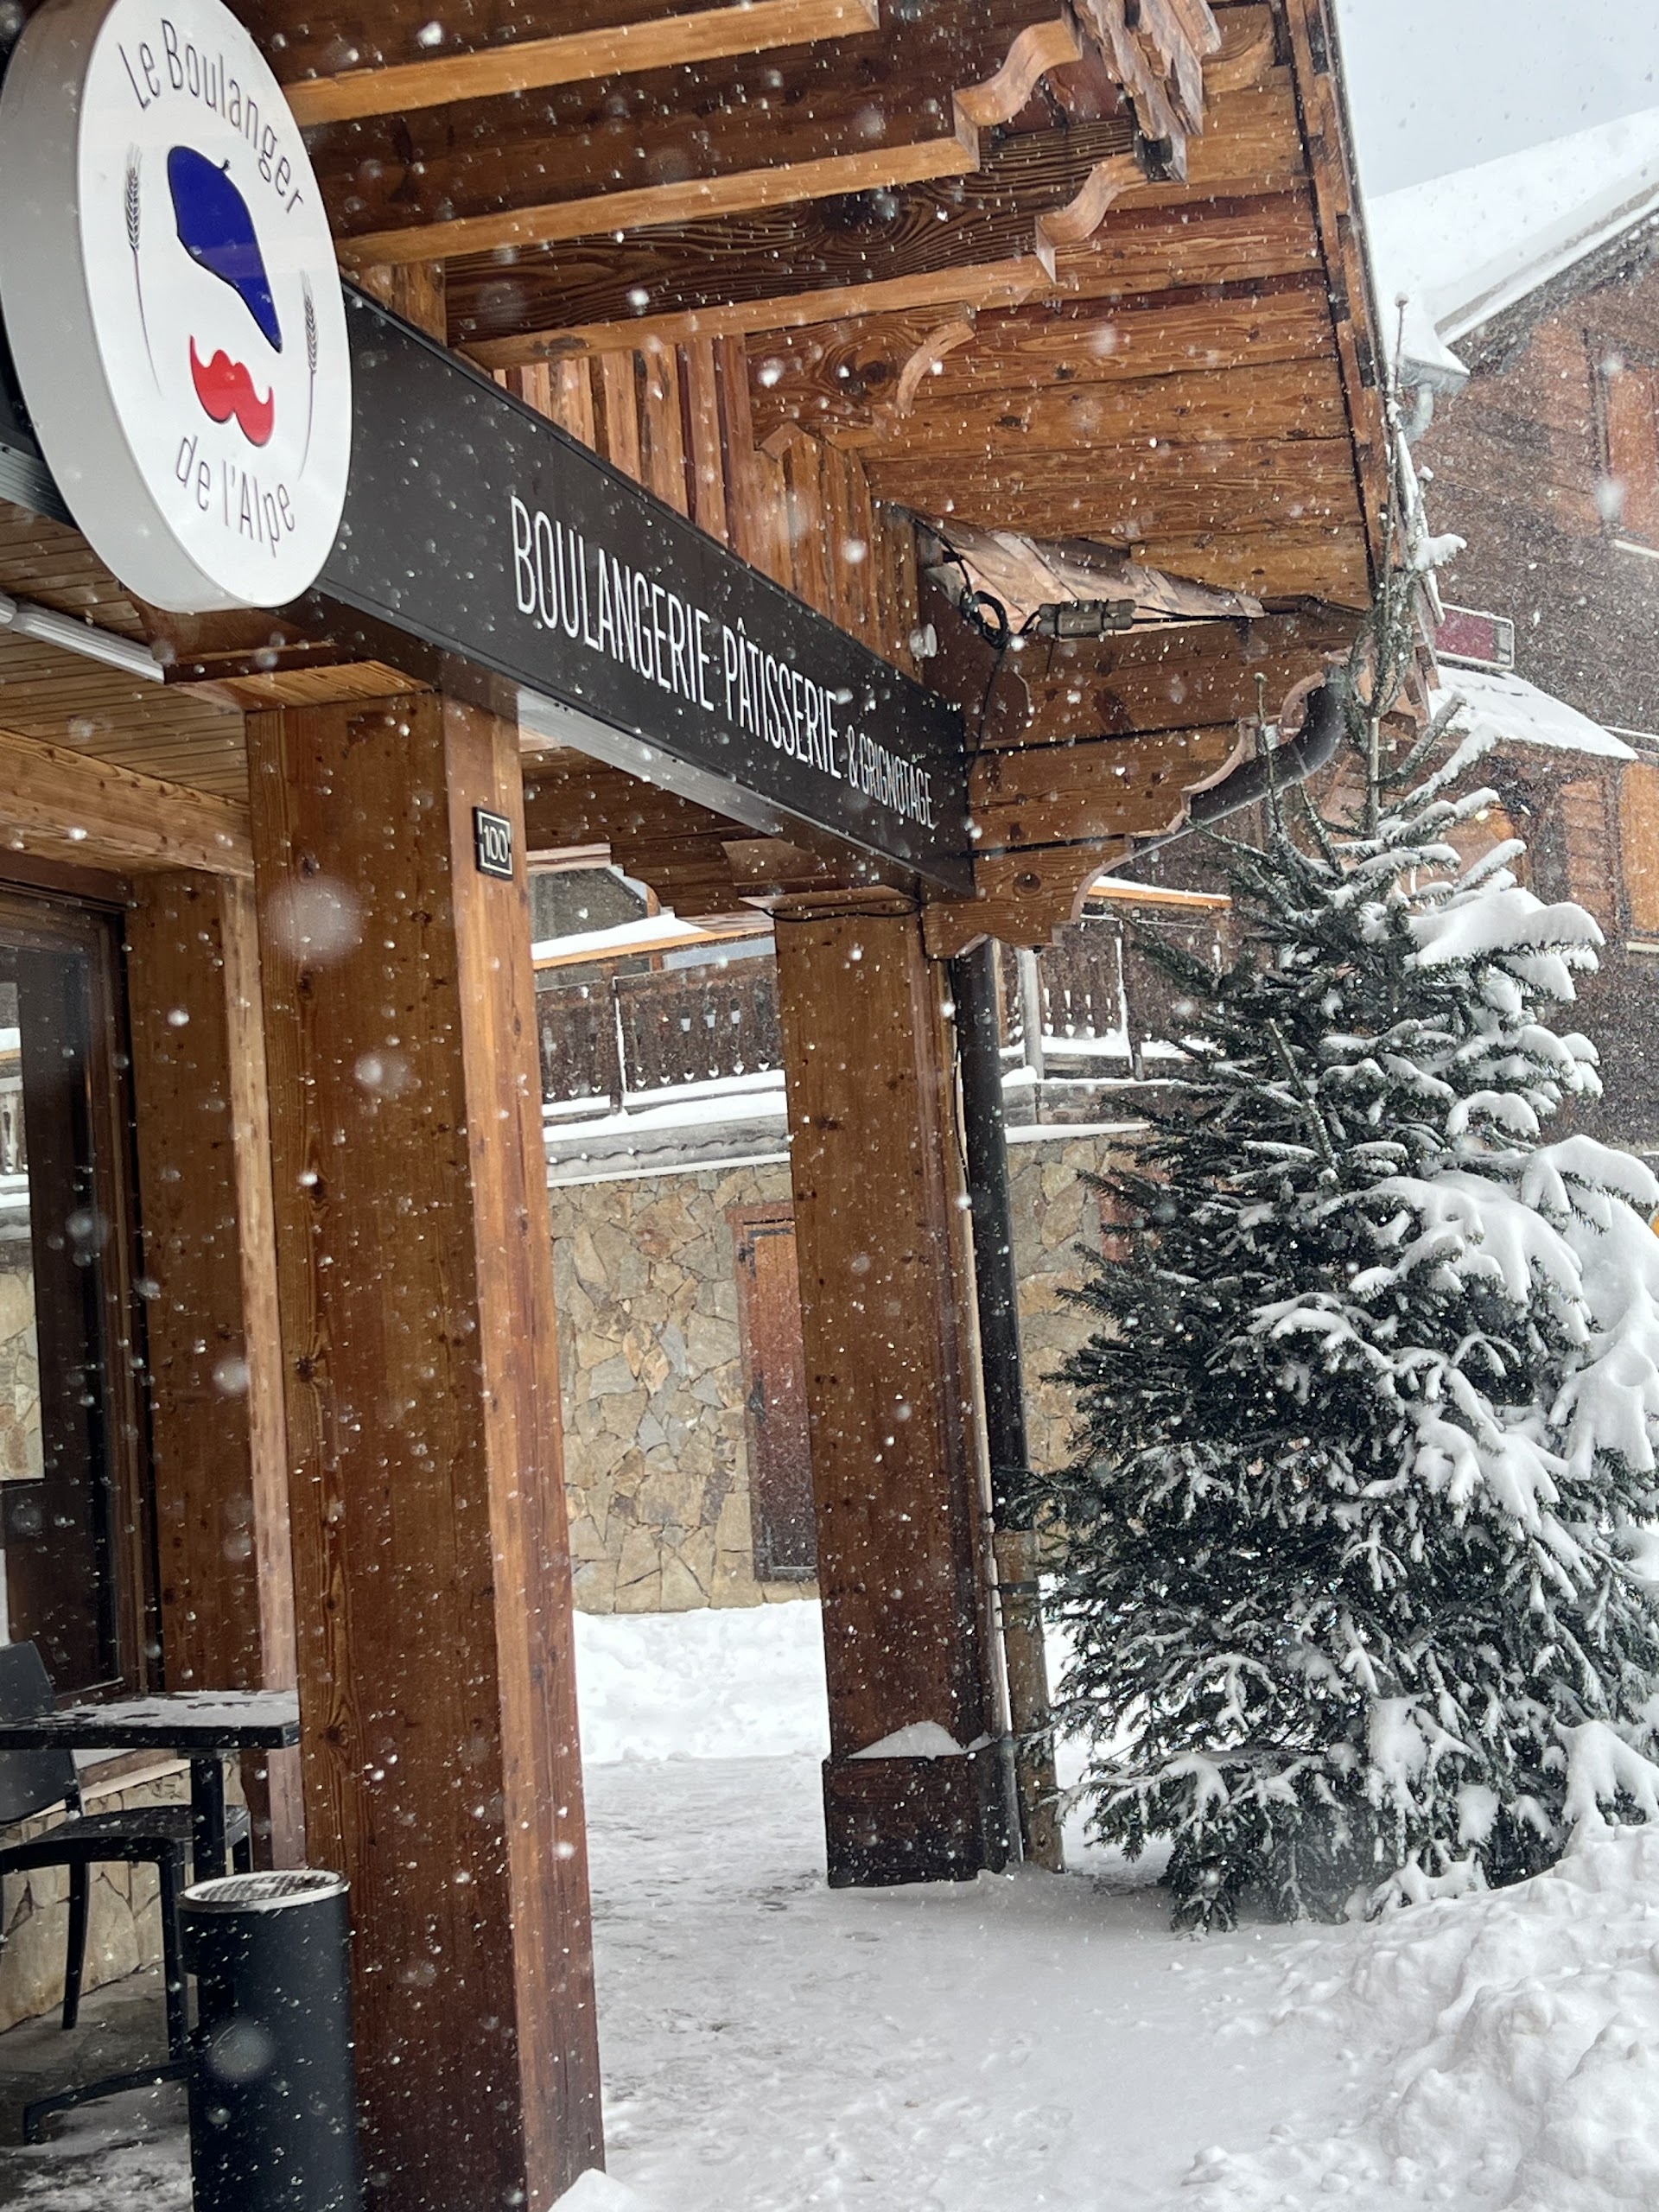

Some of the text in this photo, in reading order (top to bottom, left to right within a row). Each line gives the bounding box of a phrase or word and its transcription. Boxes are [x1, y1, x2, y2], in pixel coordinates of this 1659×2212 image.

[117, 18, 304, 213] Le Boulanger
[176, 435, 296, 558] de l'Alpe
[511, 496, 934, 830] BOULANGERIE PÂTISSERIE & GRIGNOTAGE
[483, 824, 509, 863] 100
